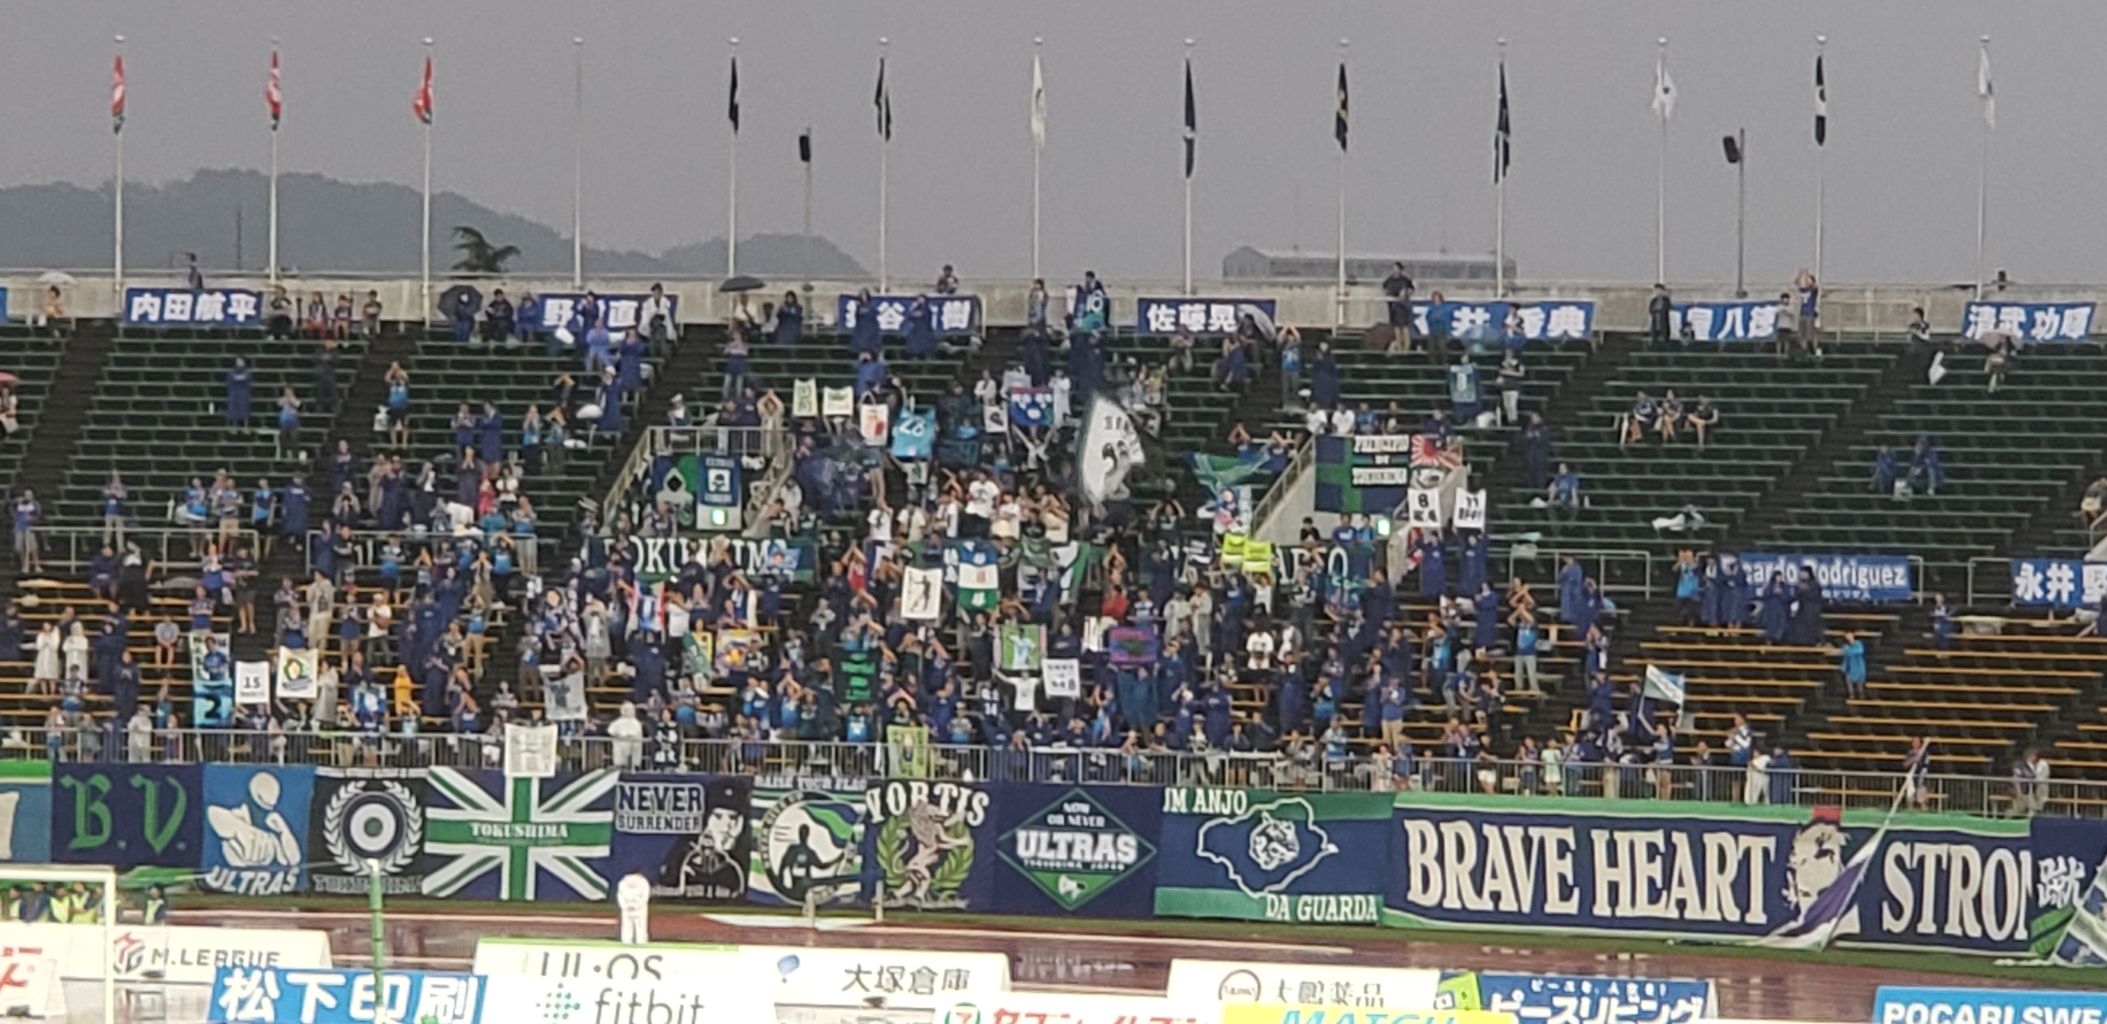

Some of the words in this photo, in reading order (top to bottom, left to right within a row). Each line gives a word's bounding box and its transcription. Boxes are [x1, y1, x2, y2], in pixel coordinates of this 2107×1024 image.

[130, 293, 257, 322] 内田航平
[619, 786, 702, 812] NEVER
[866, 781, 990, 827] VORTIS
[1192, 788, 1248, 815] ANJO
[470, 822, 569, 838] TOKUSHIMA
[618, 814, 701, 831] SURRENDER
[1068, 815, 1105, 827] NEVER
[1016, 829, 1138, 865] ULTRAS
[205, 865, 300, 896] ULTRAS
[1403, 819, 1580, 914] BRAVE
[1590, 829, 1777, 925] HEART
[1265, 894, 1291, 920] DA
[1297, 894, 1379, 922] GUARDA
[841, 963, 971, 995] 大塚倉庫
[218, 967, 480, 1024] 松下印刷
[595, 987, 705, 1024] fitbit
